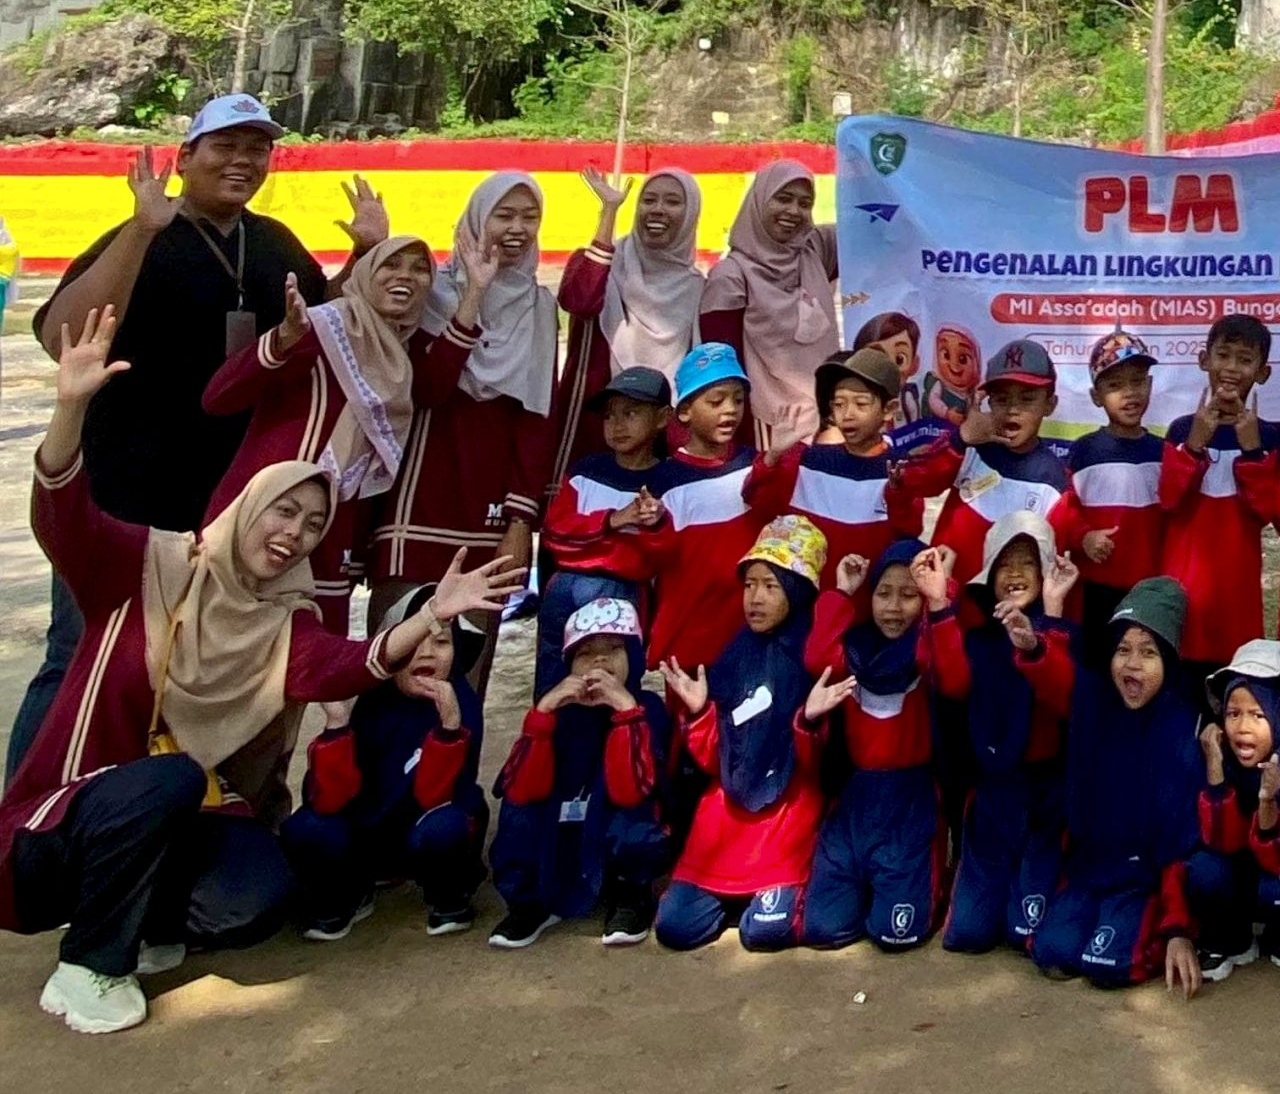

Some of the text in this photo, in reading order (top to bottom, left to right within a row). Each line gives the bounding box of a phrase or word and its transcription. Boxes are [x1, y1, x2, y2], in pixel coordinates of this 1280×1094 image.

[1084, 174, 1239, 233] PLM
[1009, 298, 1033, 315] MI
[1150, 298, 1216, 320] (MIAS)
